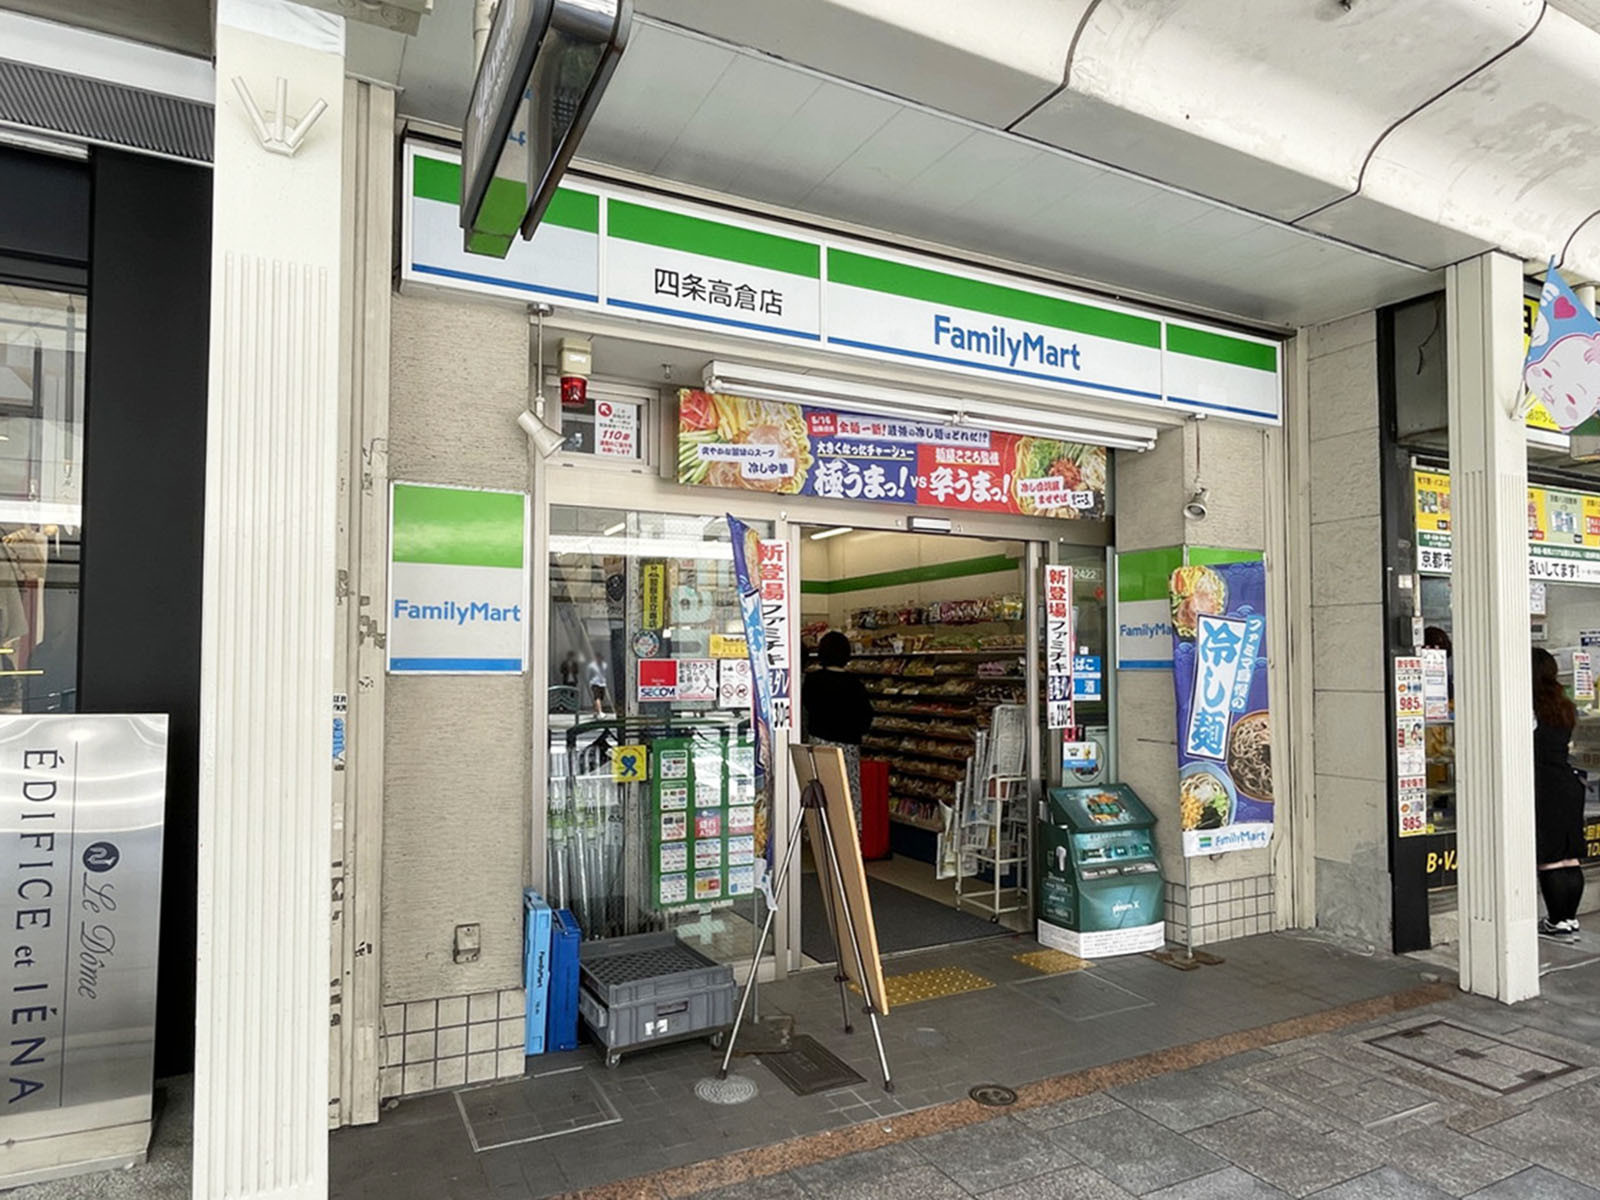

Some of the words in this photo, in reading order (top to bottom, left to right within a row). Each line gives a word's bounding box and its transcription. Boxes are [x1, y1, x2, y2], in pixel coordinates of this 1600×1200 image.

[654, 268, 783, 316] 四条高倉店
[934, 314, 1081, 371] FamilyMart
[814, 460, 908, 498] 極うまっ!
[929, 466, 1011, 503] 辛うまっ!
[394, 599, 521, 625] FamilyMart
[1120, 623, 1172, 639] FamilyMa
[1071, 657, 1095, 671] ばこ
[641, 687, 675, 697] SECOM
[1400, 696, 1420, 711] 985
[16, 749, 65, 930] ÉDIFICE
[1402, 816, 1422, 831] 985
[82, 872, 117, 913] Le
[14, 945, 35, 968] et
[78, 921, 116, 1000] Dôme
[8, 983, 57, 1104] IÉNA
